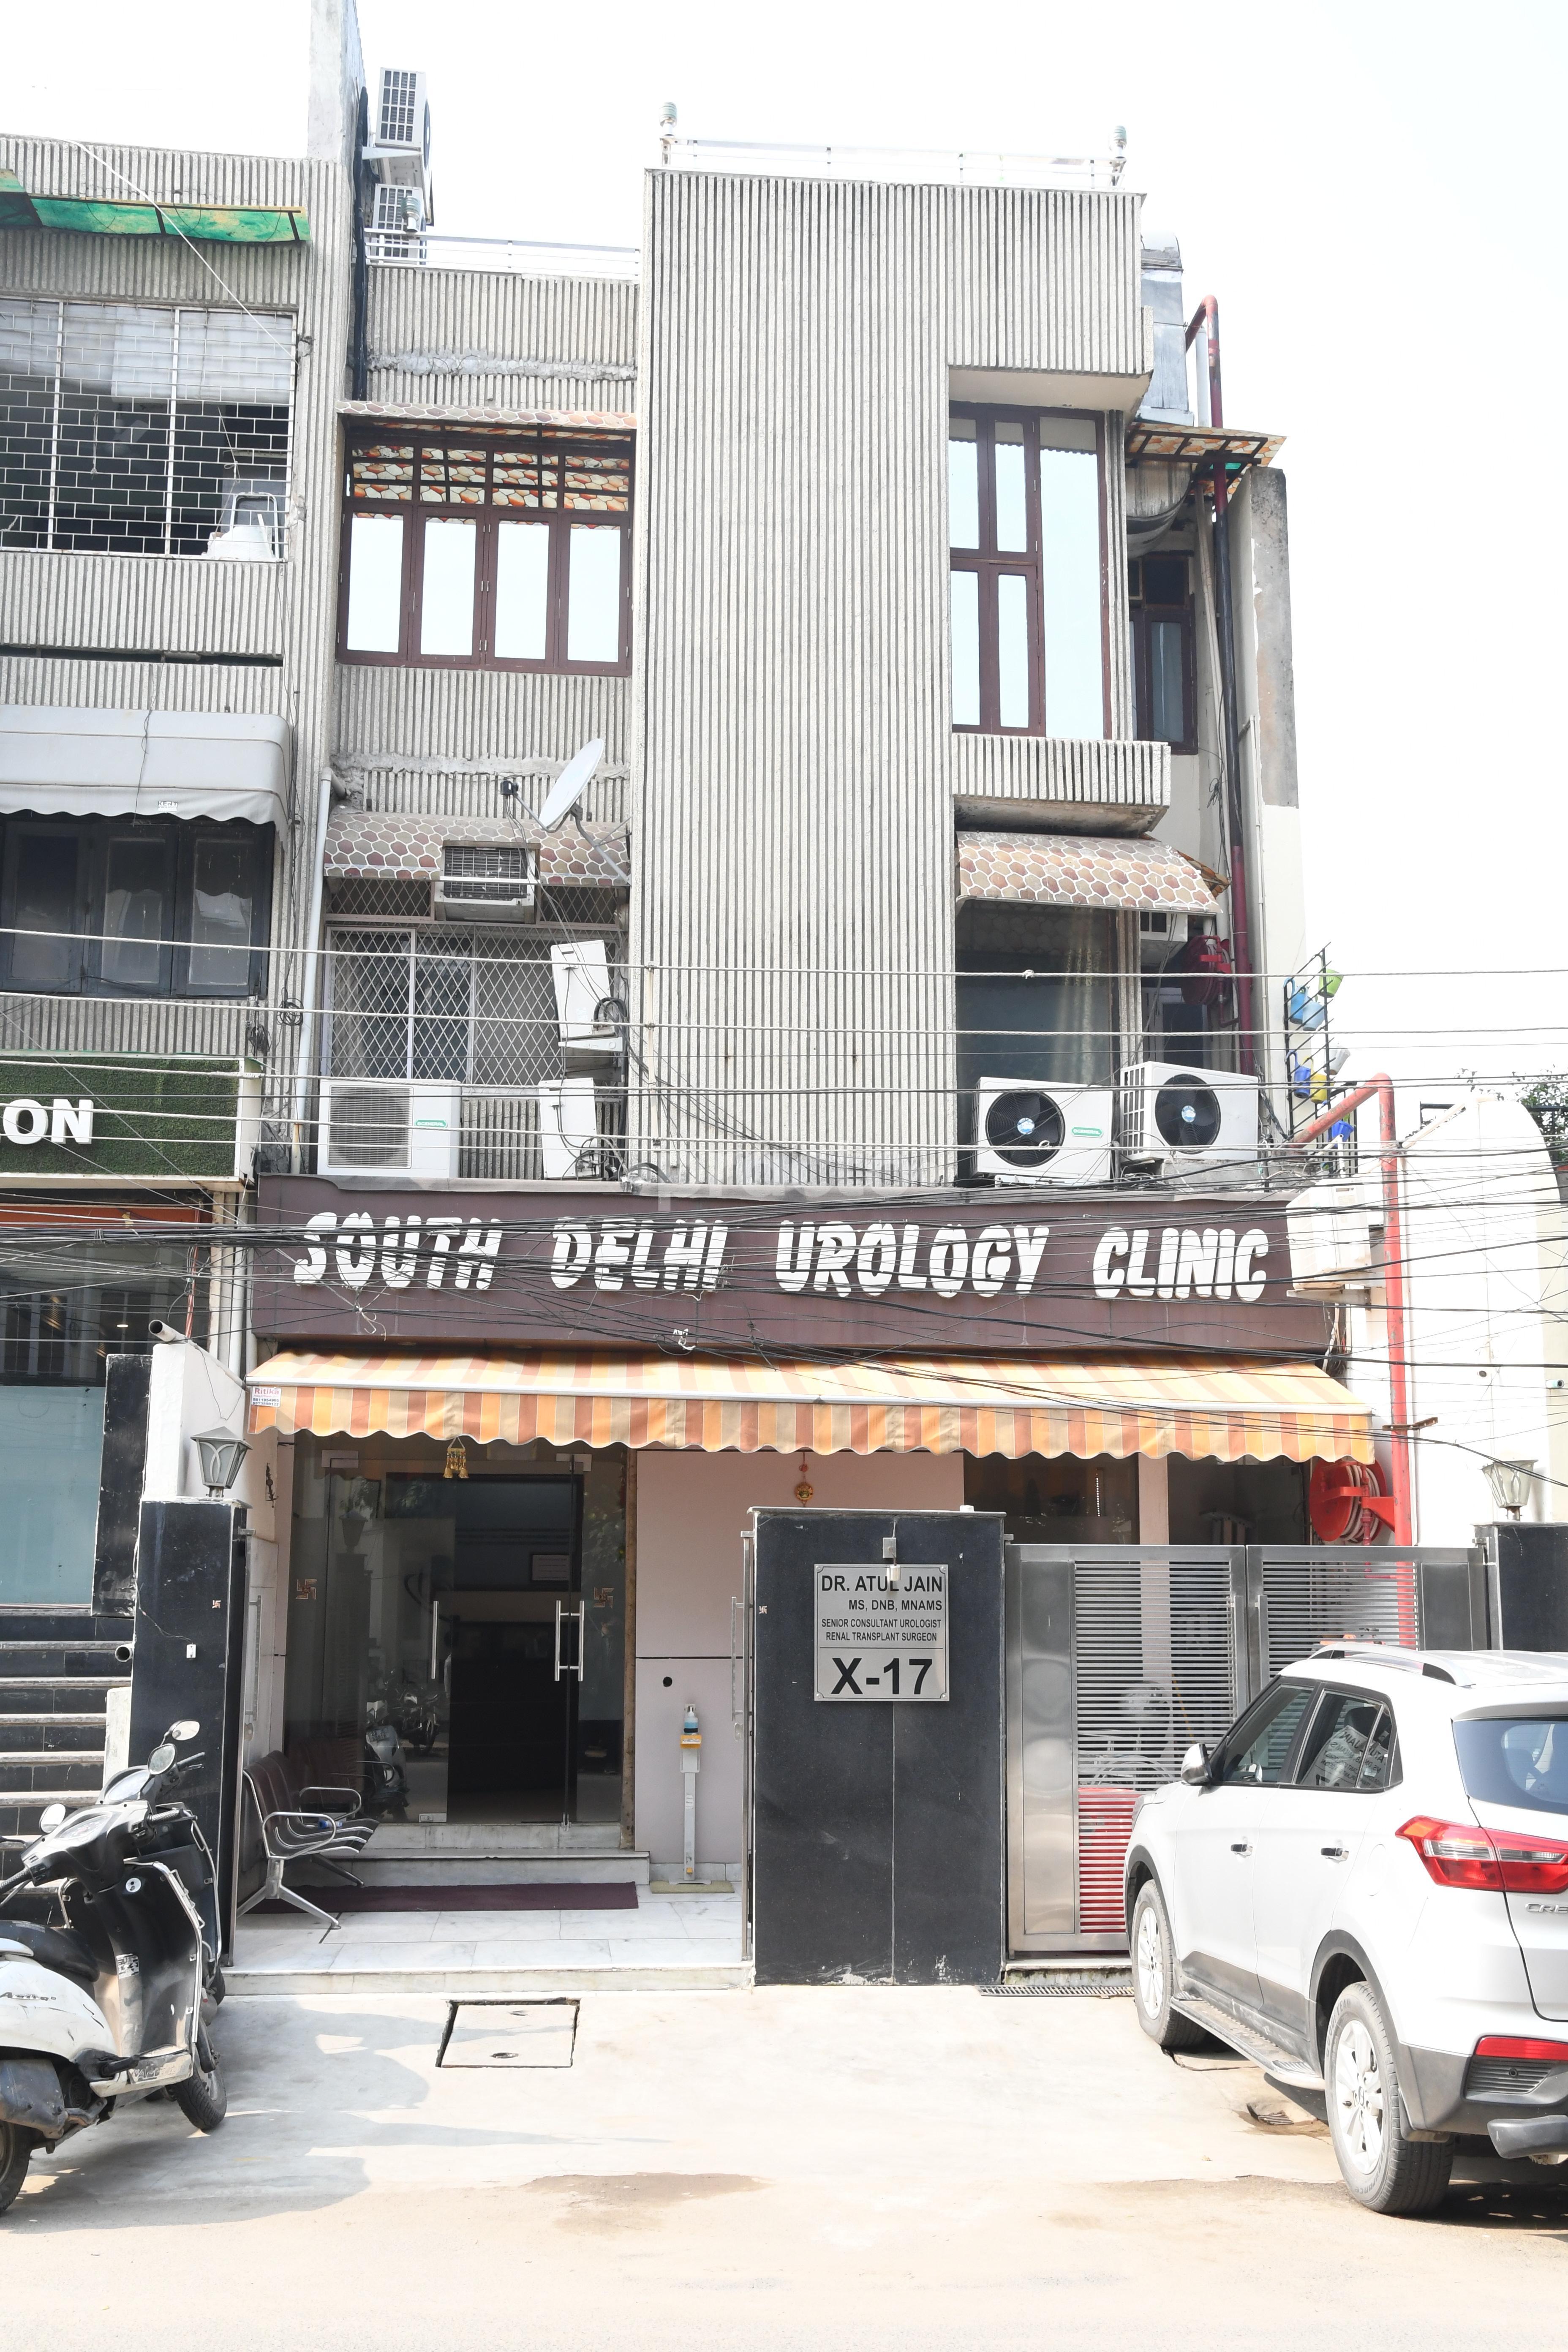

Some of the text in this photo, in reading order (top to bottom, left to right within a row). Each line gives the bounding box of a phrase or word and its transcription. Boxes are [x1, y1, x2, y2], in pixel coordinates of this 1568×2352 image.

[3, 1099, 94, 1145] ON
[293, 1211, 1269, 1301] SOUTH DELHI UROLOGY CLINIC
[822, 1575, 942, 1592] DR. ATUL JAIN
[849, 1599, 942, 1612] MS, DNB, MNAMS
[822, 1618, 942, 1628] SENIOR CONSULTANT UROLOGIST
[826, 1632, 937, 1641] RENAL TRANSPLANT SURGEON
[830, 1657, 933, 1695] X-17
[1525, 1903, 1568, 1913] CRE
